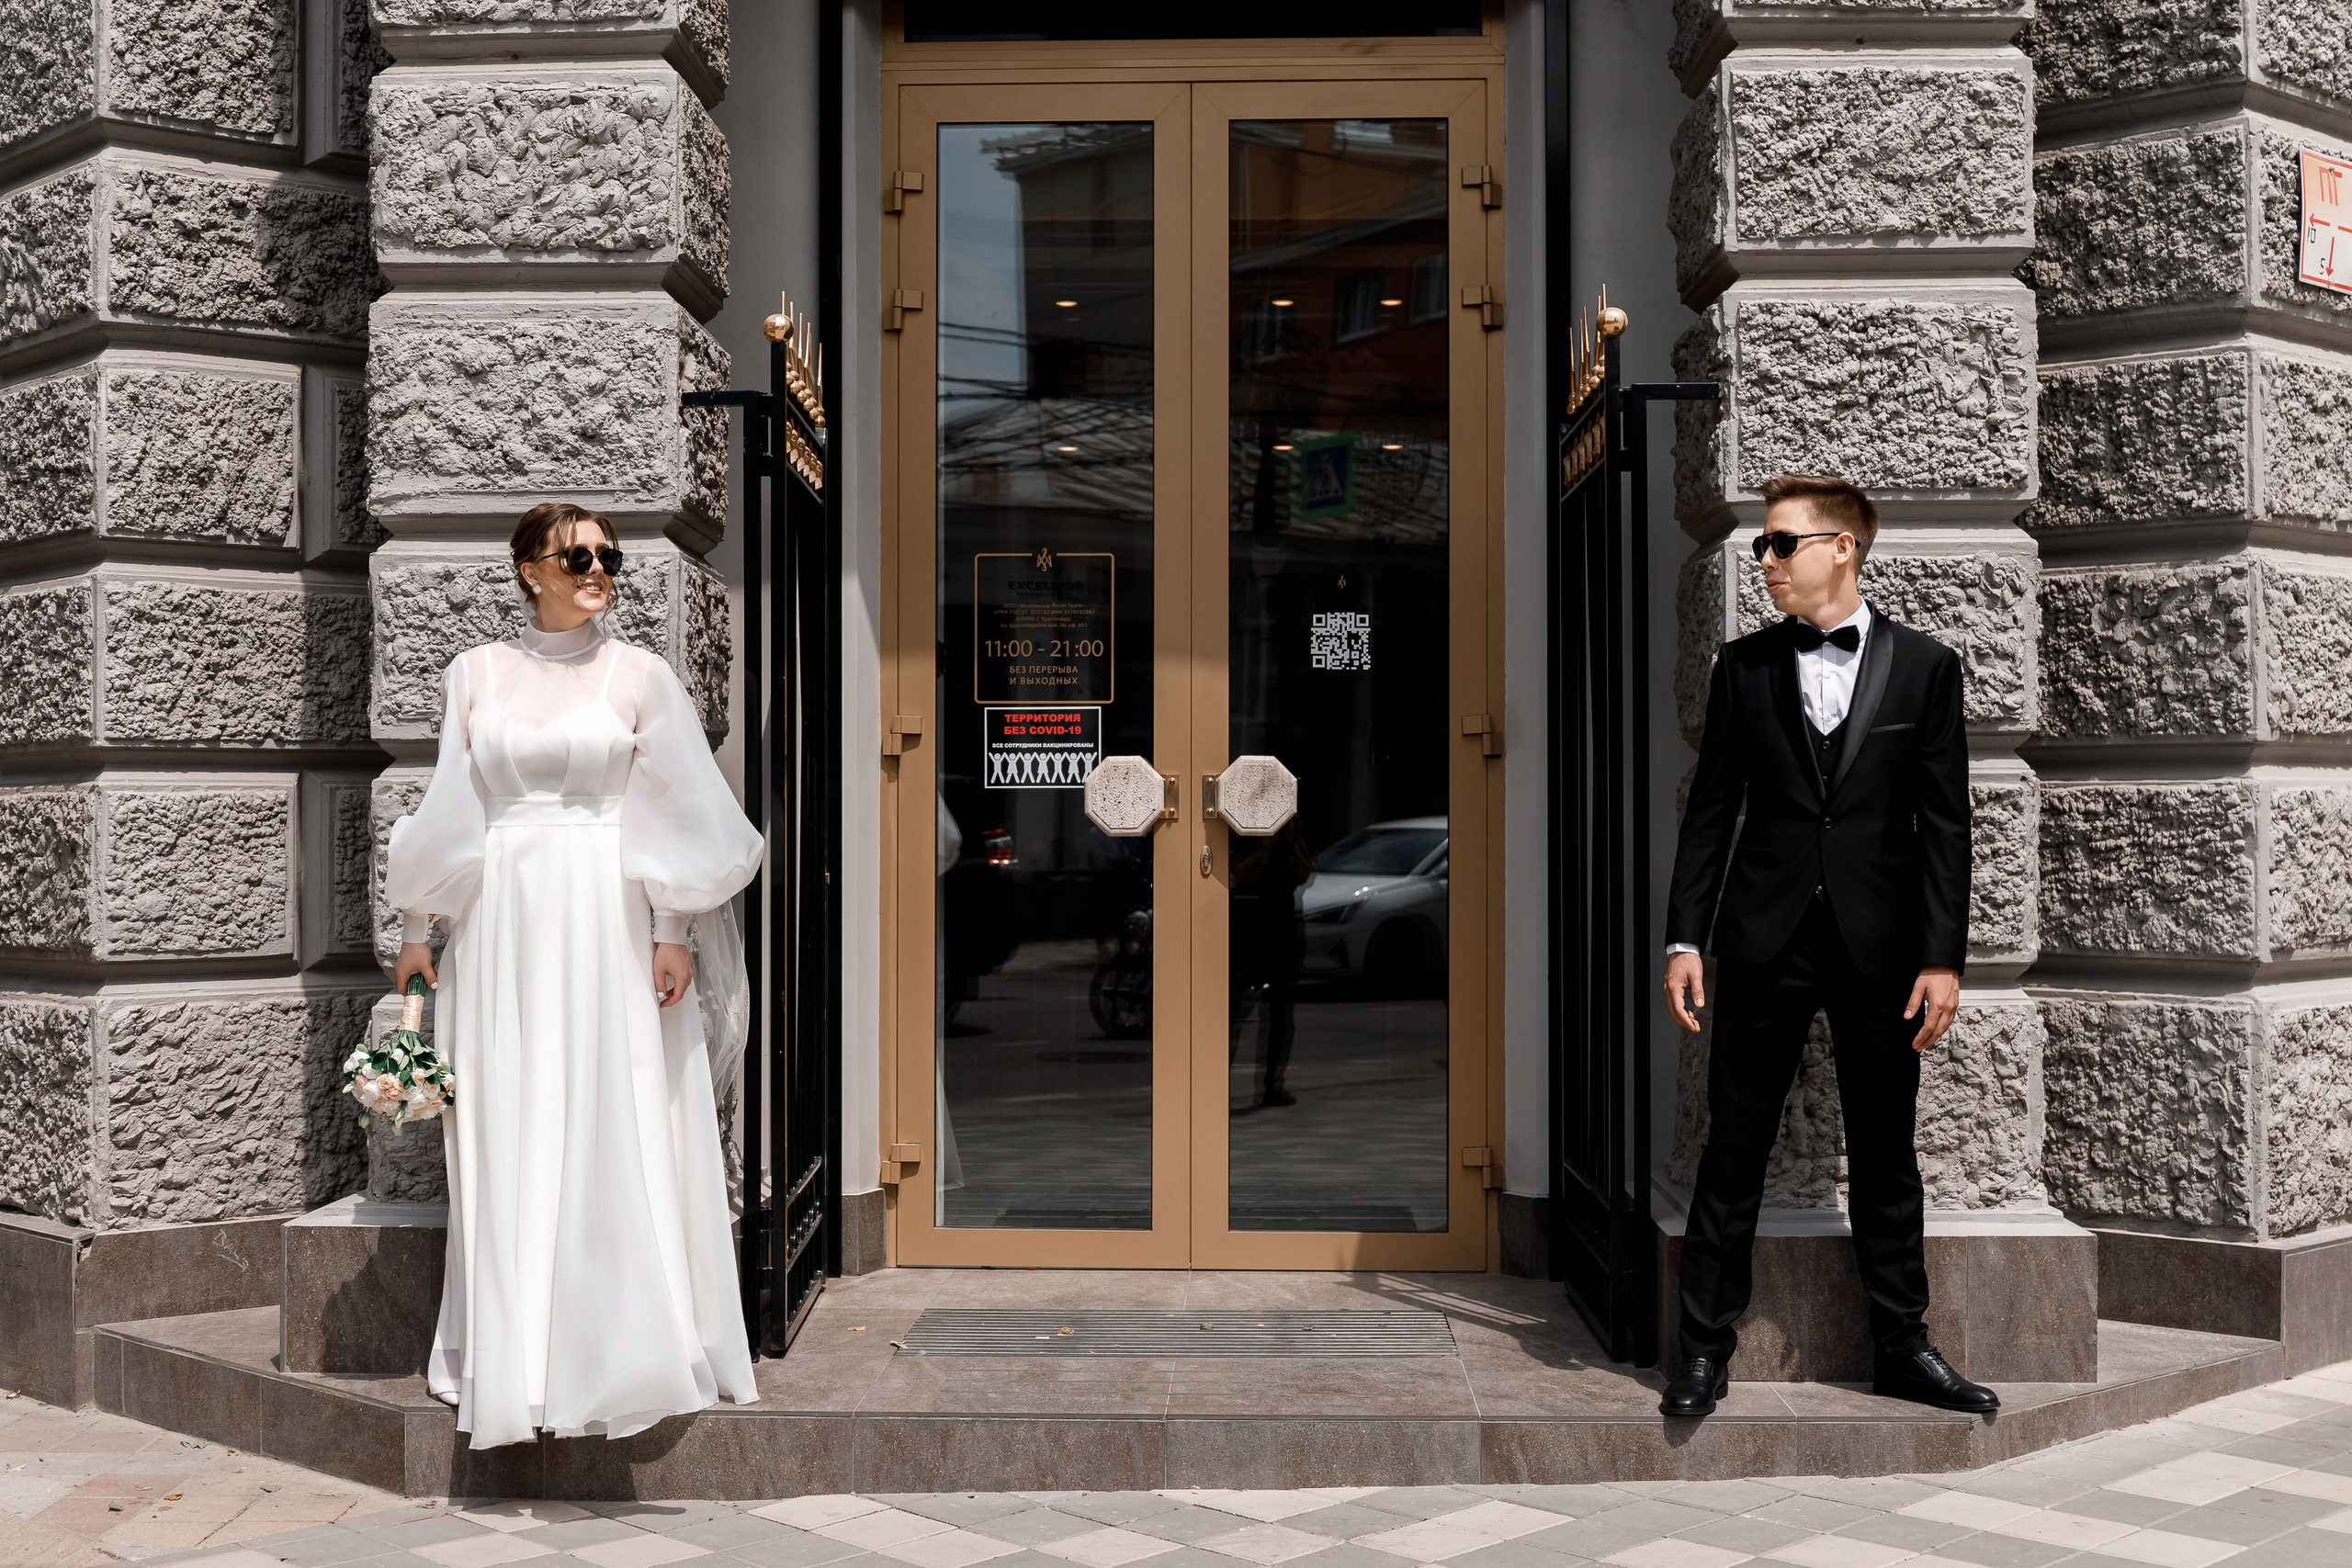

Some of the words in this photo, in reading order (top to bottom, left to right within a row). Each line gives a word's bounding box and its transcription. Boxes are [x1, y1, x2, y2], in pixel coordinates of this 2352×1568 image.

[985, 640, 1032, 657] 11:00
[1050, 640, 1103, 657] 21:00
[1021, 677, 1078, 685] ВЫХОДНЫХ
[1004, 714, 1080, 722] ТЕРРИТОРИЯ
[1004, 727, 1026, 735] БЕЗ
[1029, 726, 1081, 735] COVID-19
